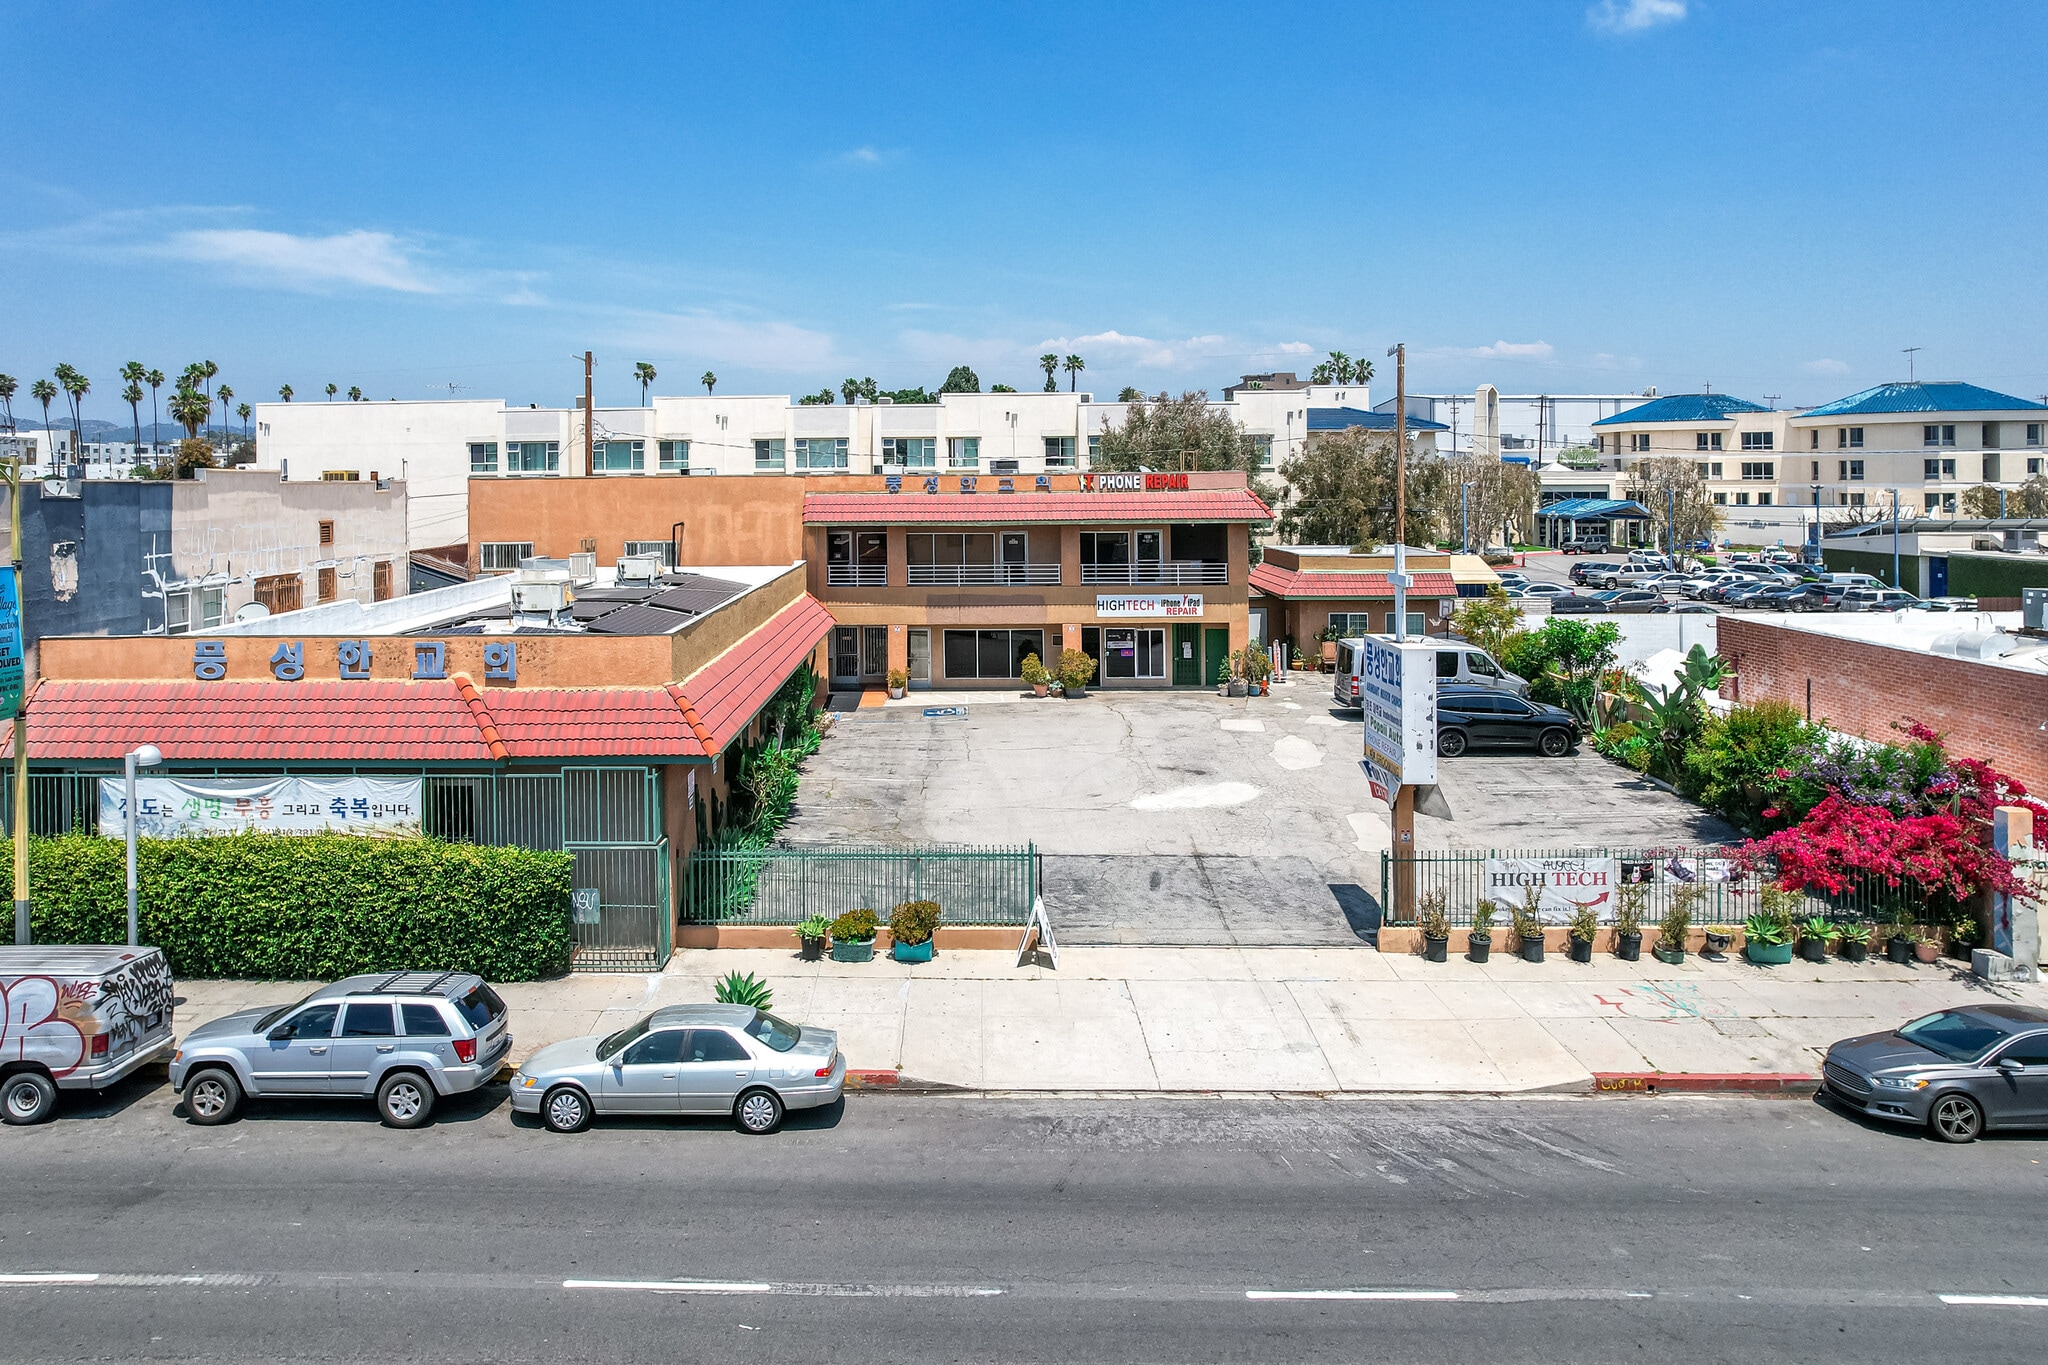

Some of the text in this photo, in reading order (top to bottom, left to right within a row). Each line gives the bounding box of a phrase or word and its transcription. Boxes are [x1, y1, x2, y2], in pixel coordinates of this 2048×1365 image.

[1100, 475, 1140, 488] PHONE
[1146, 474, 1189, 489] REPAIR
[1097, 600, 1155, 611] HIGHTECH
[1161, 599, 1200, 607] iPhone iPad
[1166, 607, 1198, 615] REPAIR
[193, 640, 516, 681] 풍성한교회
[1366, 641, 1401, 687] 풍성한교회
[282, 804, 321, 816] 그리고
[1491, 871, 1608, 887] HIGH TECH
